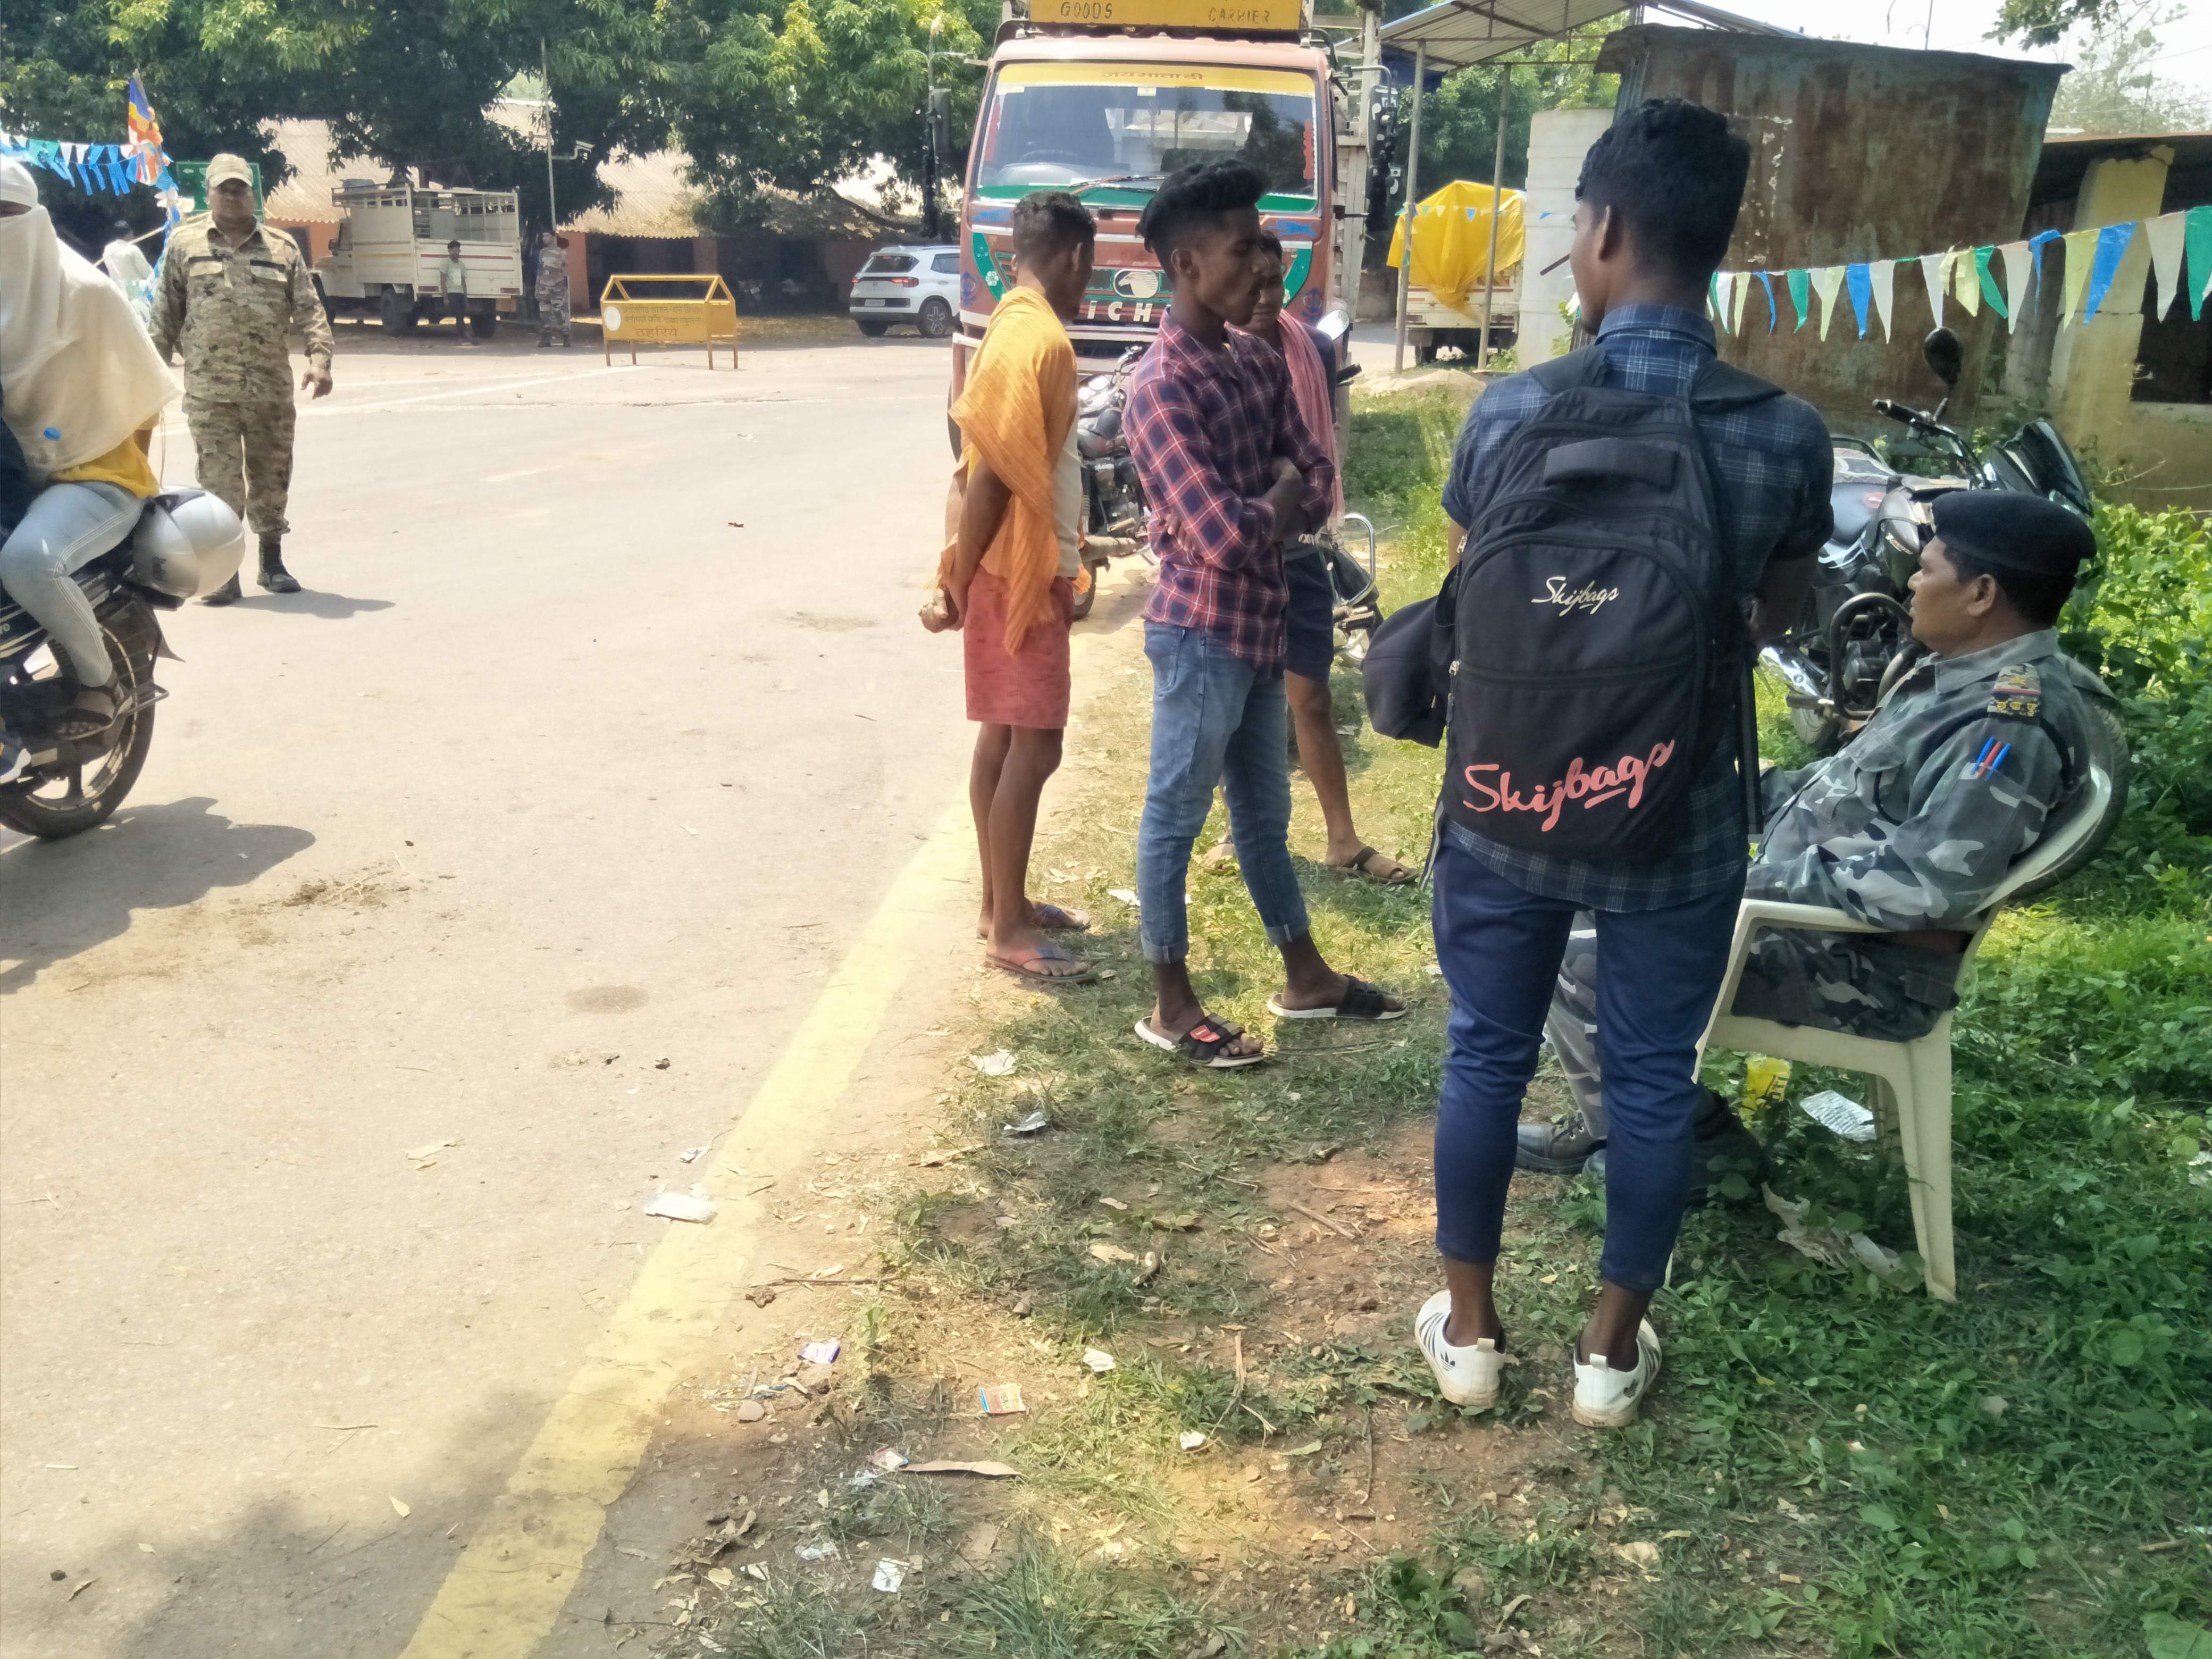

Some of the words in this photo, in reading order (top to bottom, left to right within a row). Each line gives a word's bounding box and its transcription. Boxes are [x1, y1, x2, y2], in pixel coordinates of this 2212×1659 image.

[1060, 2, 1112, 19] GOODS
[1208, 7, 1270, 24] CARRIER
[634, 325, 678, 338] ठहरिये
